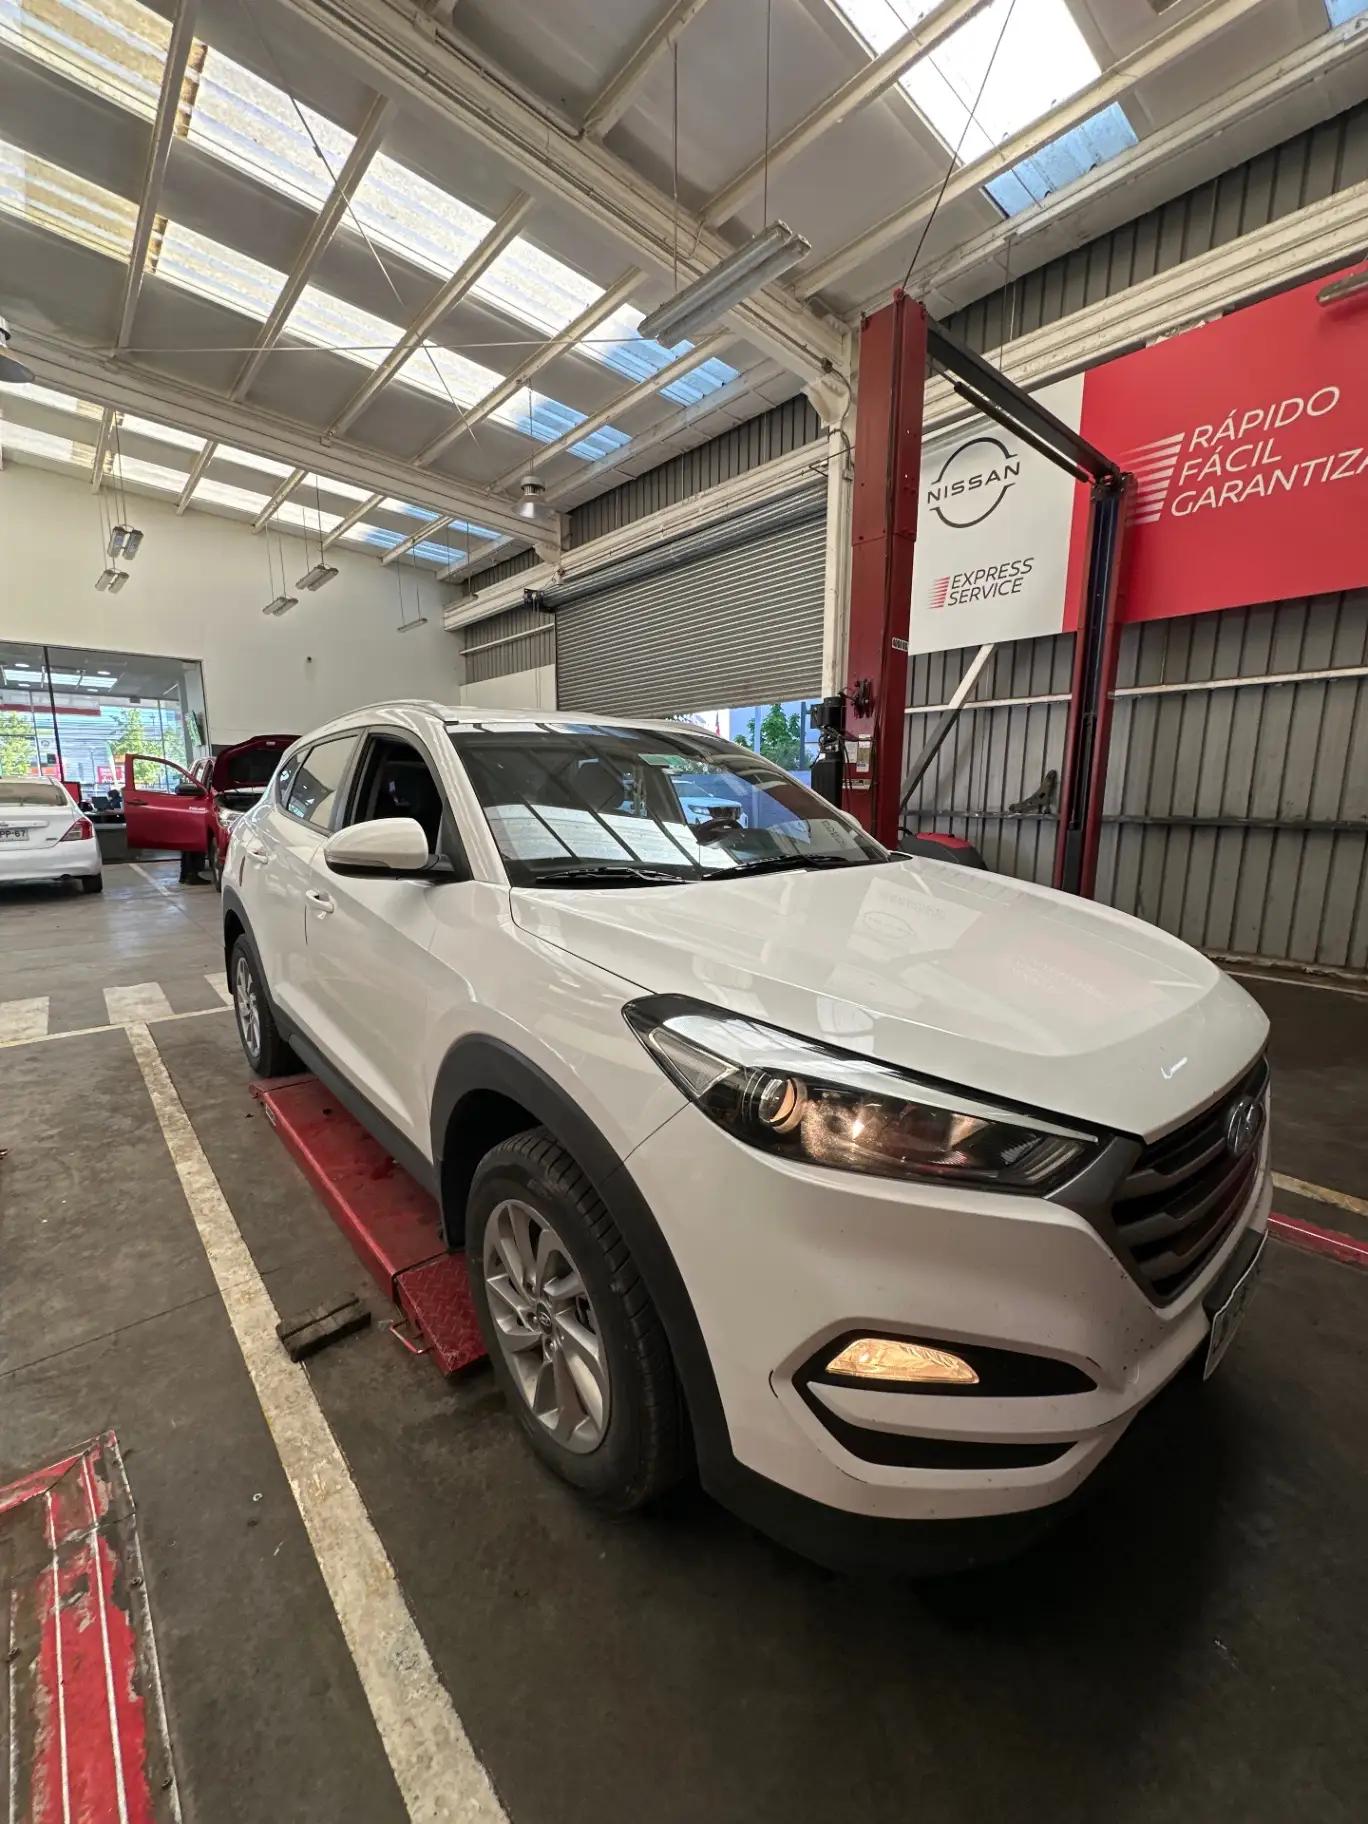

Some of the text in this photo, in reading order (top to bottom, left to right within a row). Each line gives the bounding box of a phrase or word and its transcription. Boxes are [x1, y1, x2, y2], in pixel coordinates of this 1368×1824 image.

[1189, 386, 1340, 452] RÁPIDO
[927, 462, 1020, 504] NISSAN
[1178, 438, 1282, 486] FÁCIL
[948, 577, 1024, 606] SERVICE
[951, 557, 1034, 589] EXPRESS
